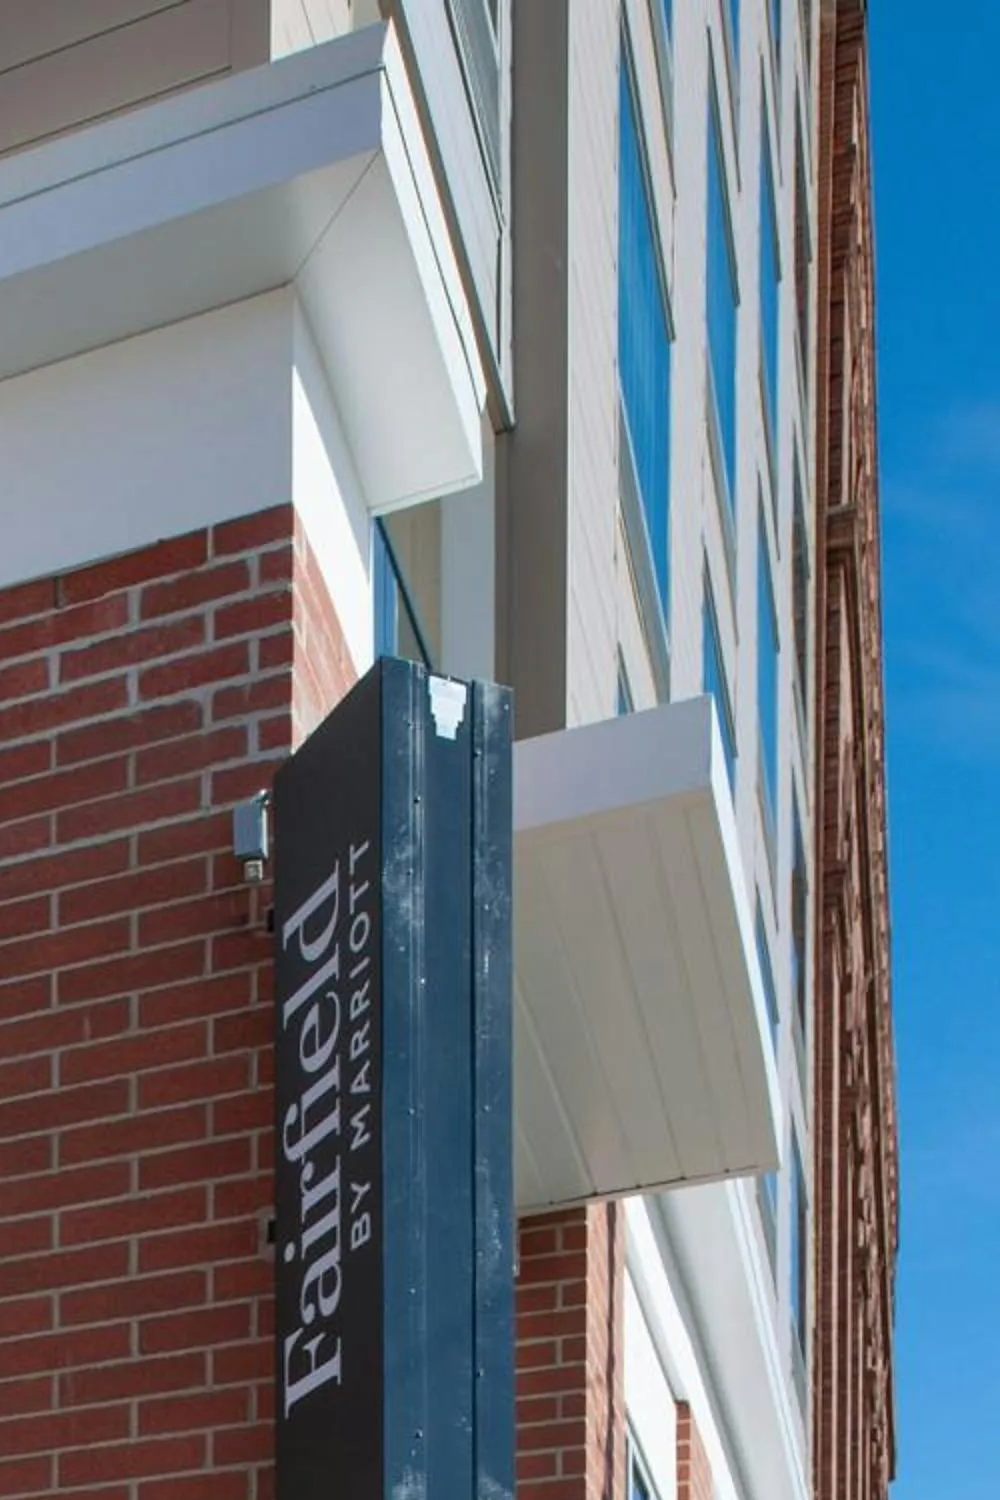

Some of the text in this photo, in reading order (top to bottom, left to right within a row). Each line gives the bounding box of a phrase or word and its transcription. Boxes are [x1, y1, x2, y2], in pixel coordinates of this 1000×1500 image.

[283, 860, 341, 1418] Fairfield
[350, 840, 371, 1250] BY MARRIOTT
